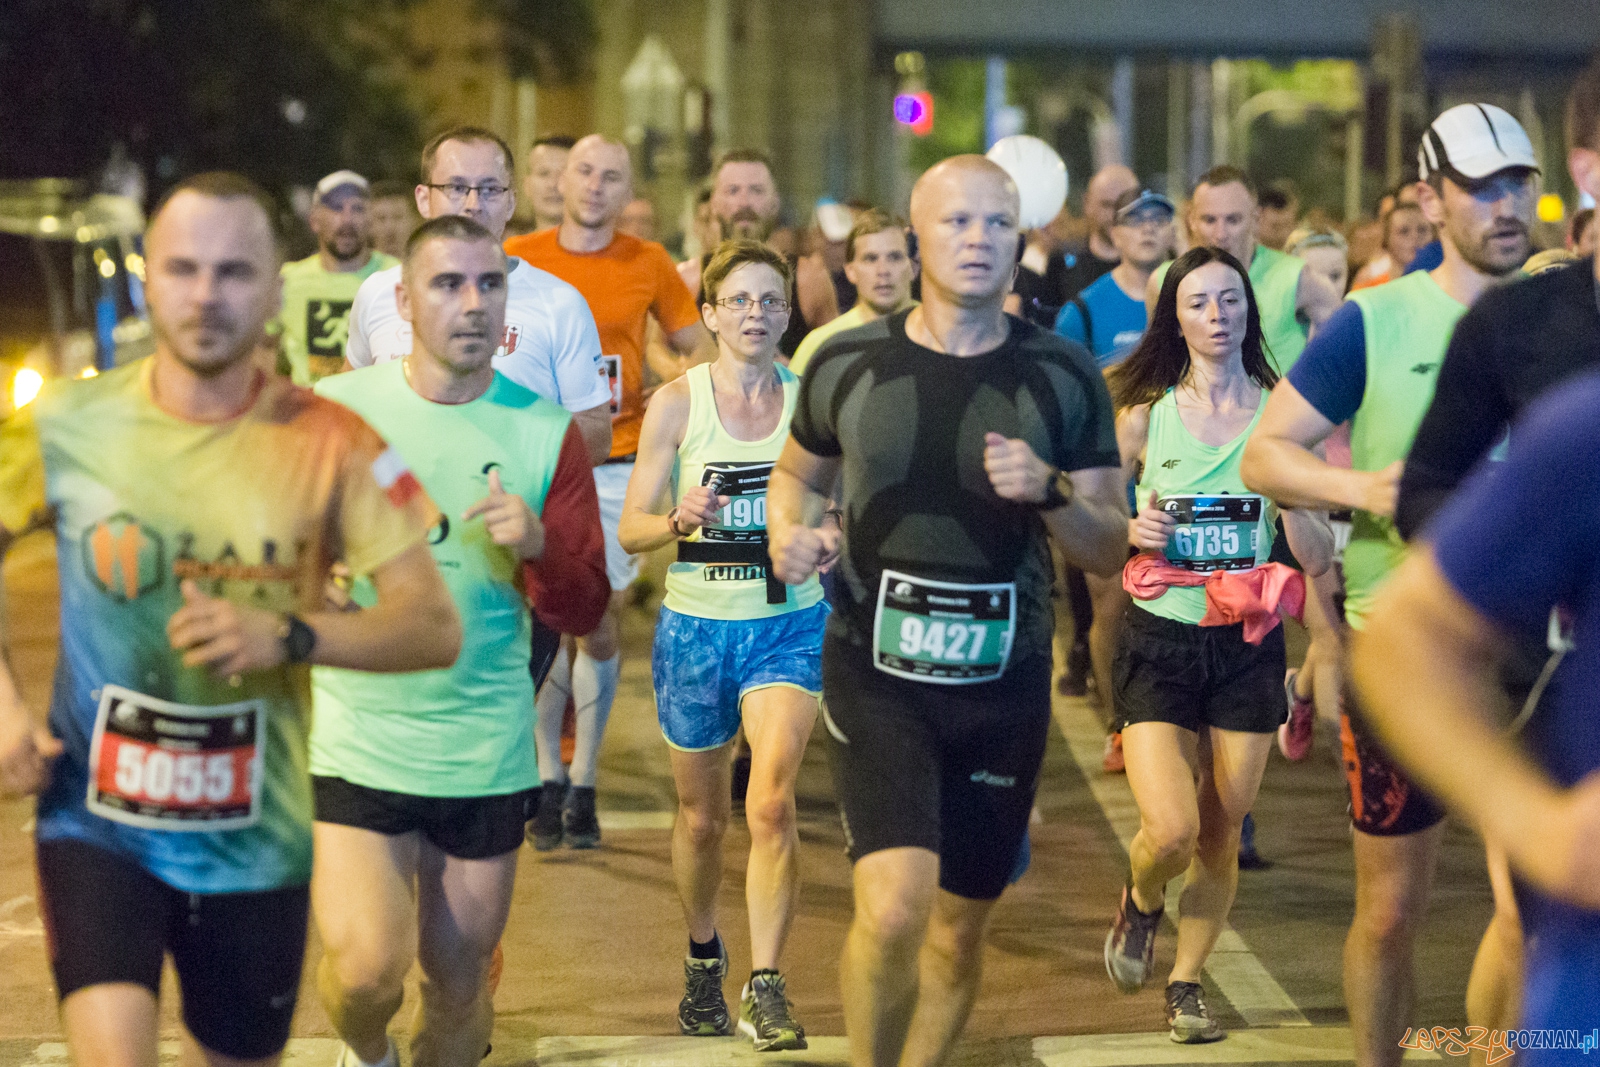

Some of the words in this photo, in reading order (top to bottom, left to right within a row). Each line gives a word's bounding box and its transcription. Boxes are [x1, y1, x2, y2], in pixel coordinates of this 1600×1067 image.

[1161, 459, 1182, 470] 4F
[1175, 525, 1239, 557] 6735
[899, 616, 987, 661] 9427
[115, 742, 233, 803] 5055
